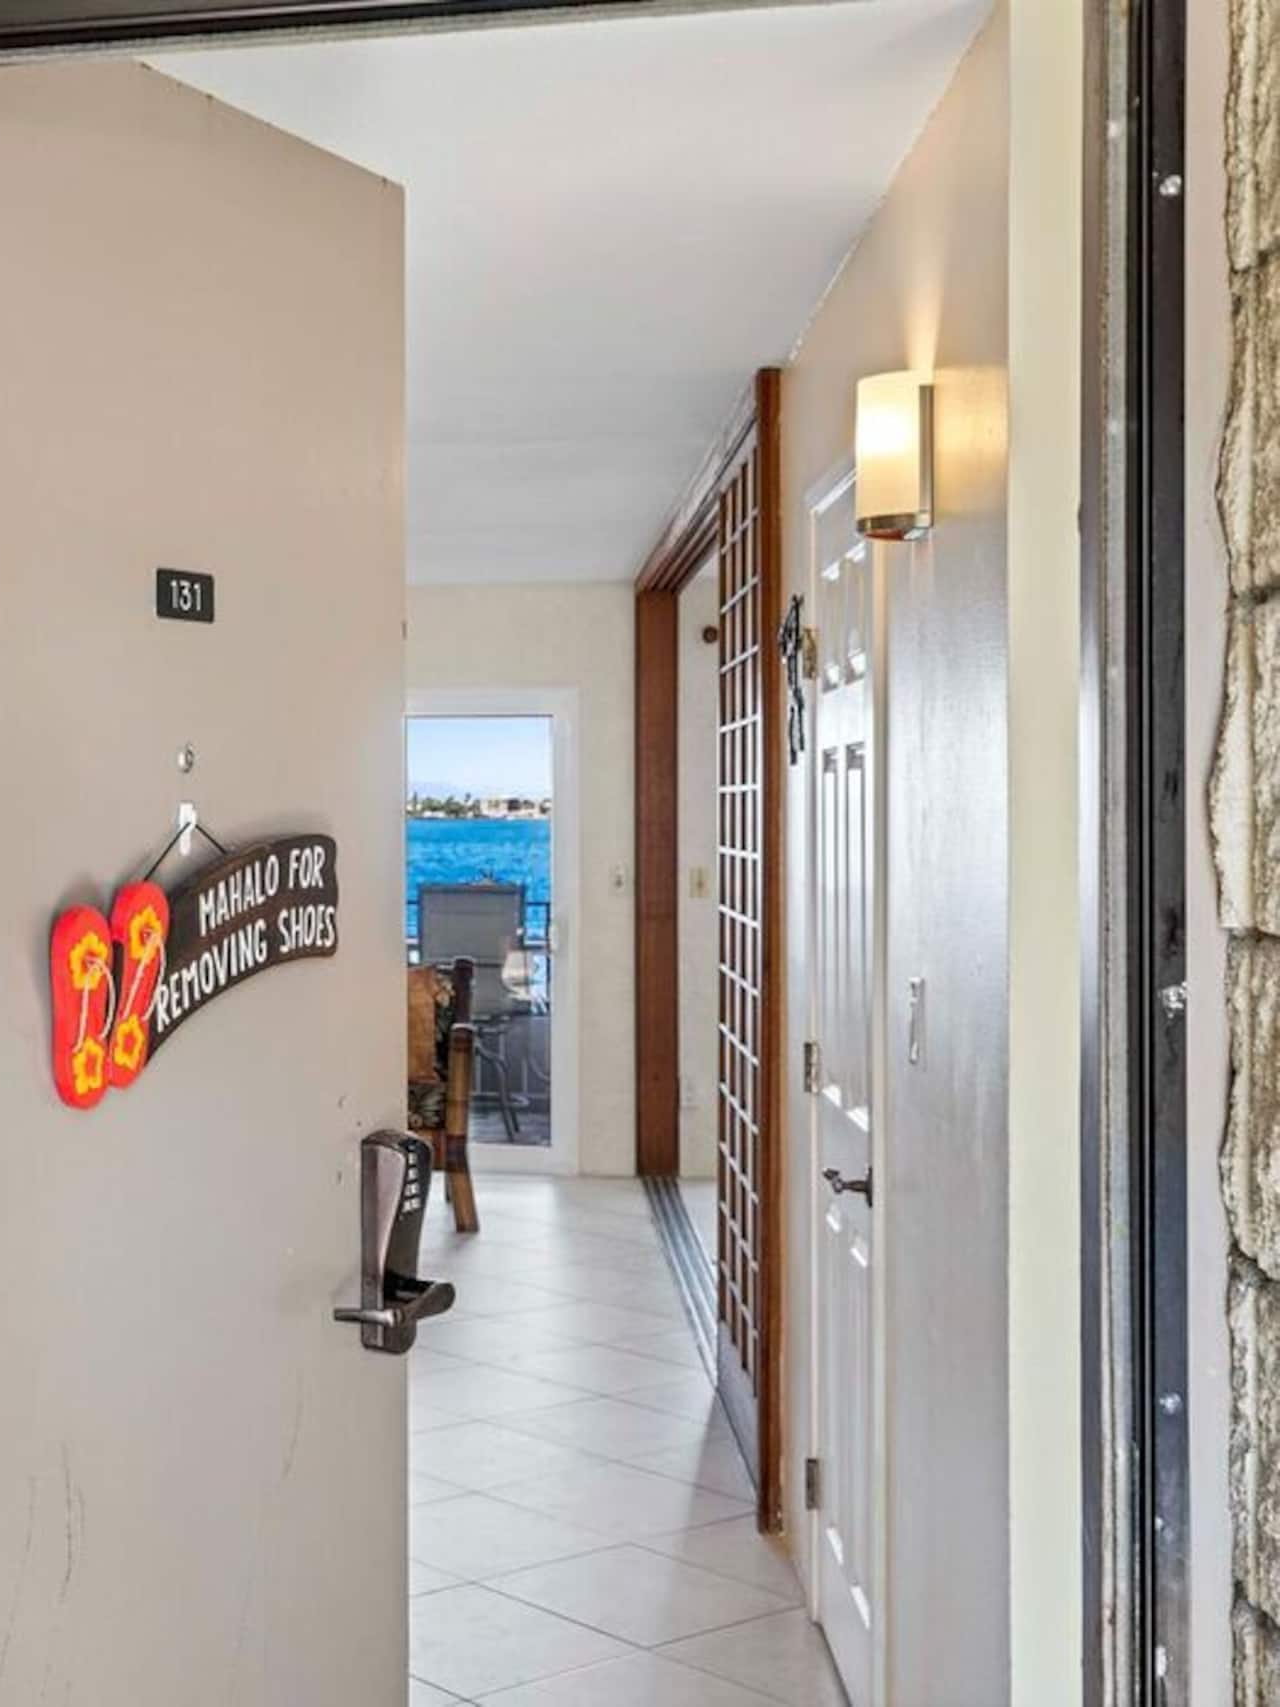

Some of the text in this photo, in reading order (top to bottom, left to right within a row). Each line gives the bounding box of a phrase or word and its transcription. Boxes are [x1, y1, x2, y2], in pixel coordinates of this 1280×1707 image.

[170, 579, 202, 612] 131
[199, 845, 325, 937] MAHALO FOR
[156, 905, 336, 1033] REMOVING SHOES
